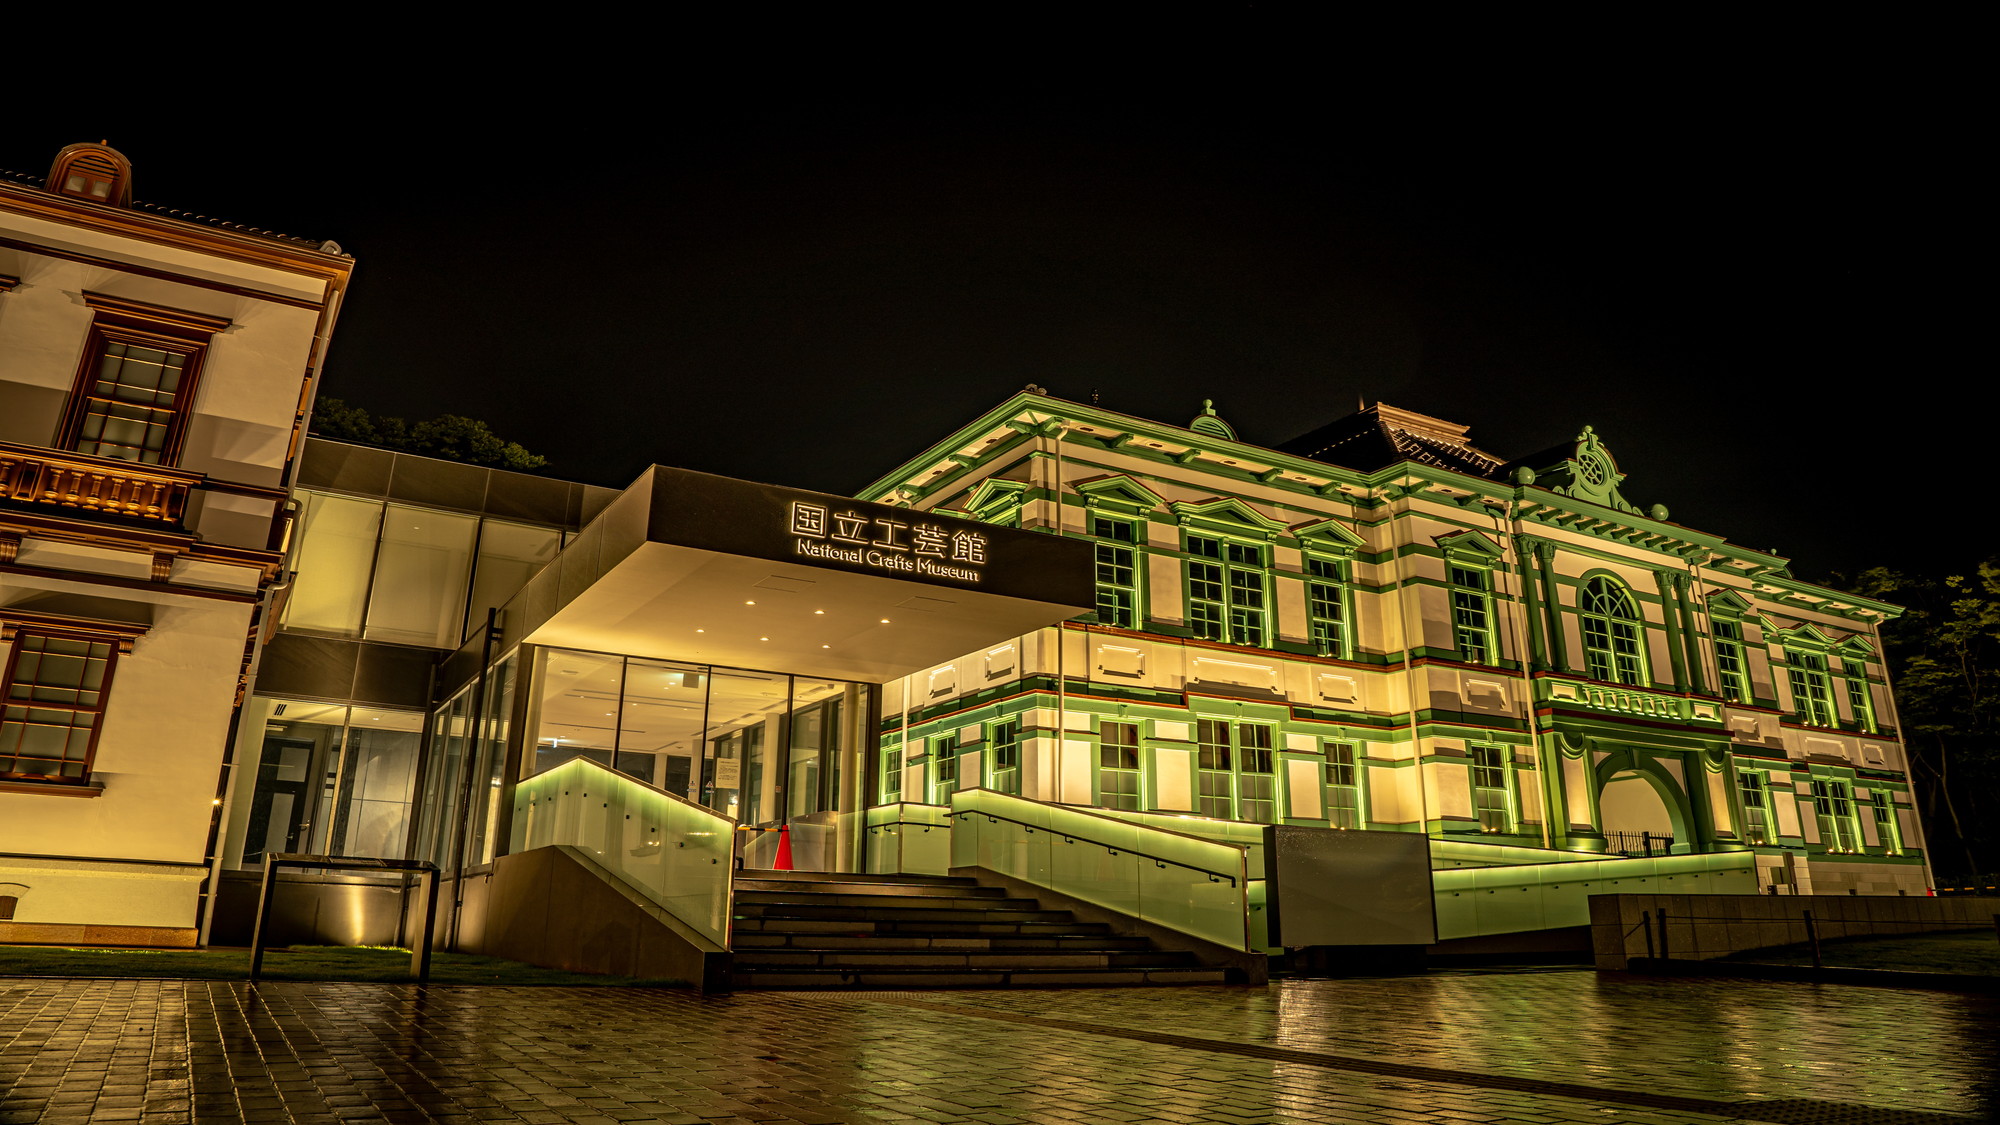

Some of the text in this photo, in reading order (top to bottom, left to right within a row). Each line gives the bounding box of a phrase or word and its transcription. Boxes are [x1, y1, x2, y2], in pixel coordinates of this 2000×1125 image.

[791, 501, 987, 564] 国立工芸館
[797, 538, 979, 581] National Crafts Museum
